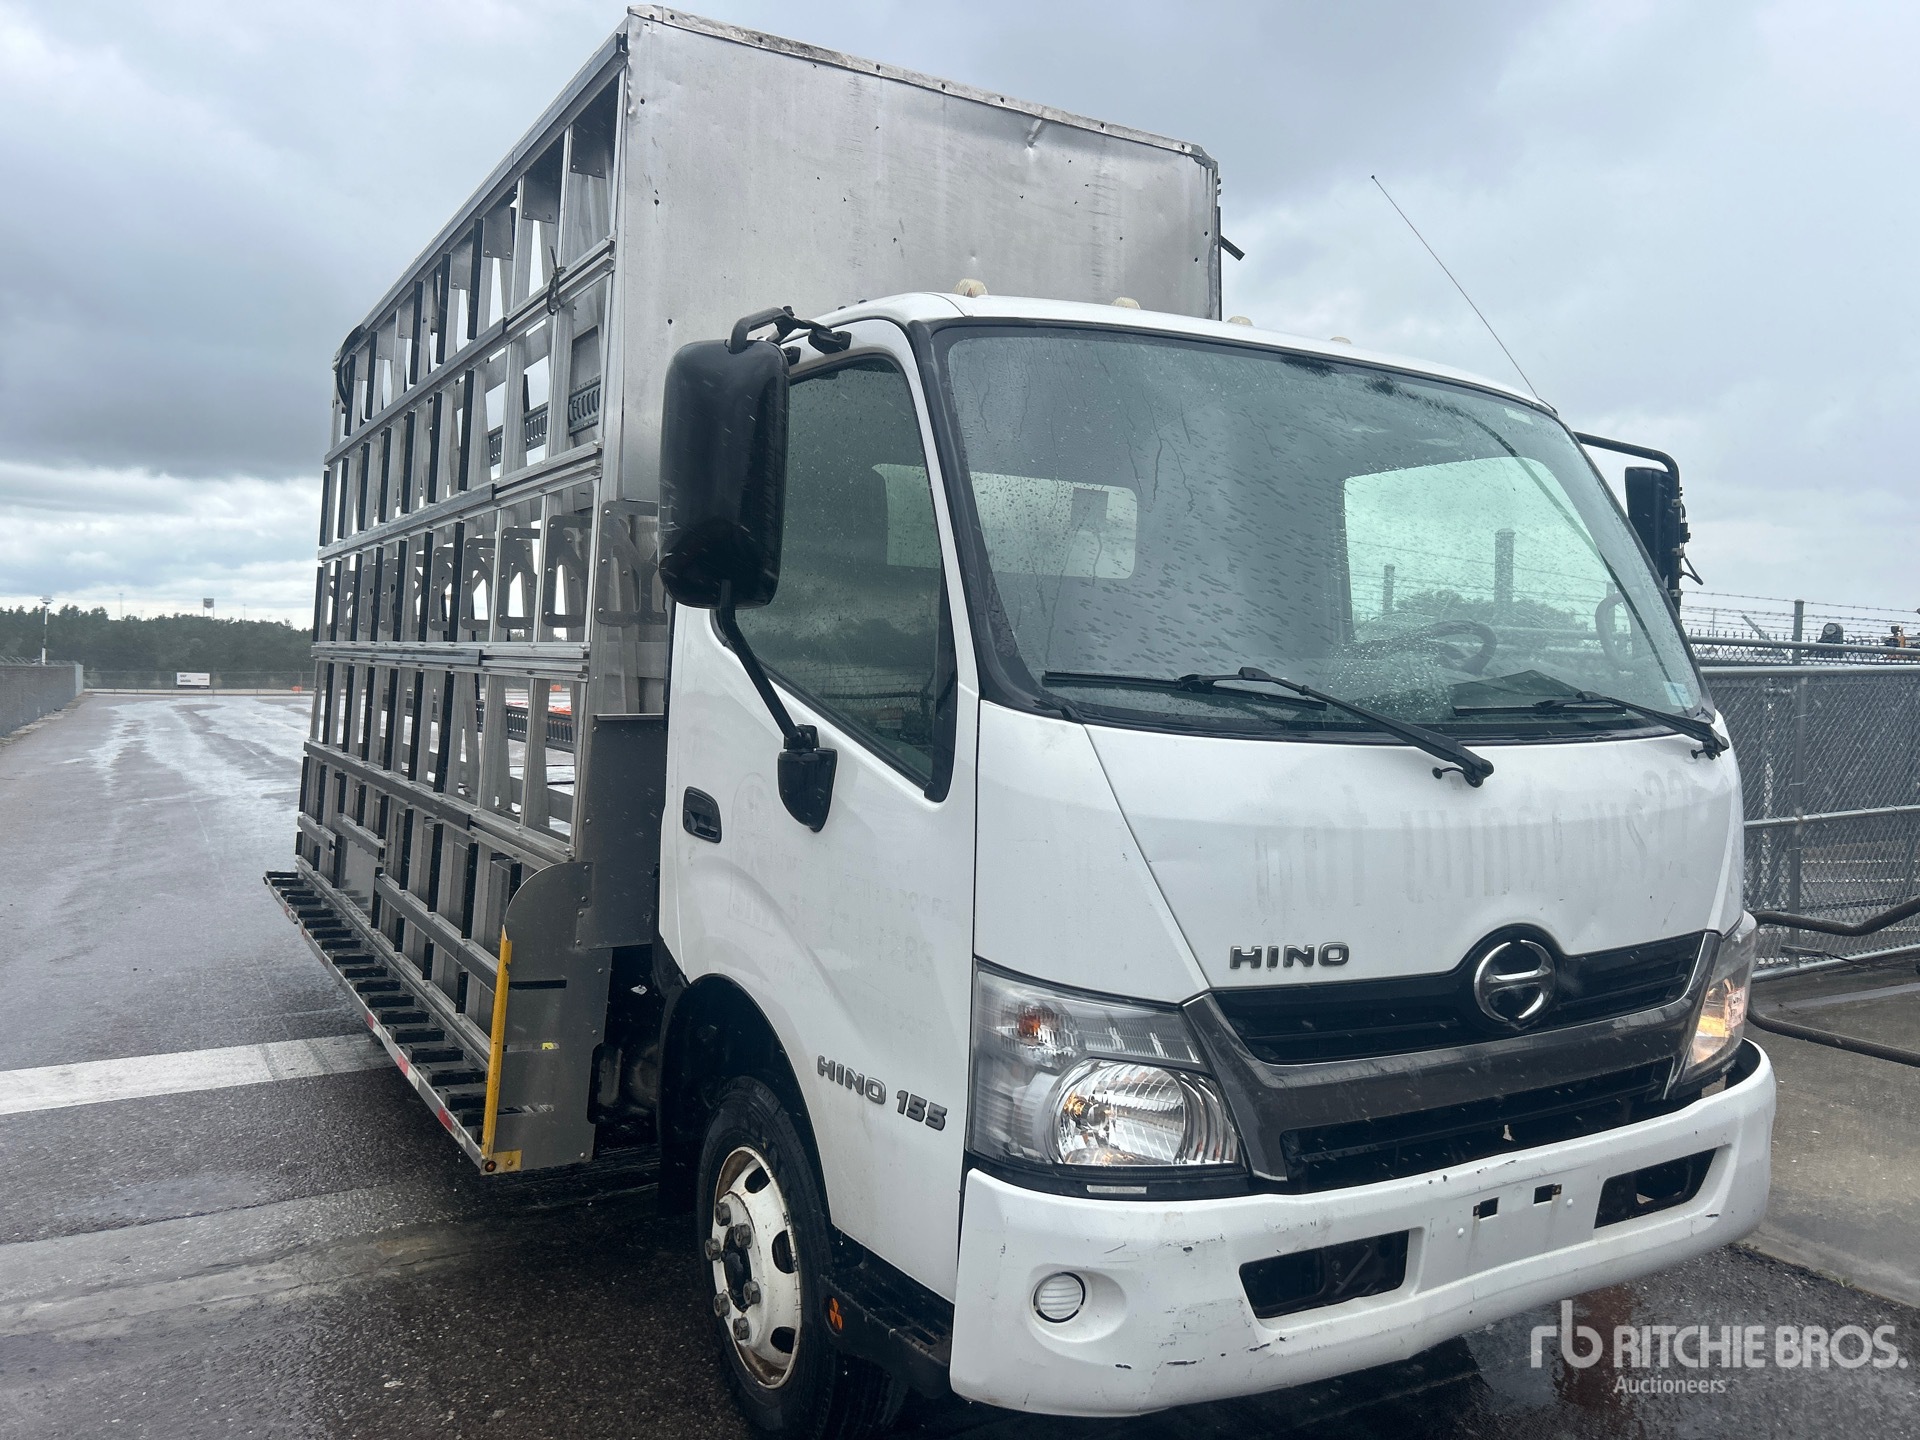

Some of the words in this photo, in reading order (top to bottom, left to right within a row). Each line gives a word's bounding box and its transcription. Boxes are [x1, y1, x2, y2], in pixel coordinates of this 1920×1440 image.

[1229, 942, 1350, 970] HINO
[817, 1055, 887, 1105] HINO
[896, 1089, 948, 1132] 155
